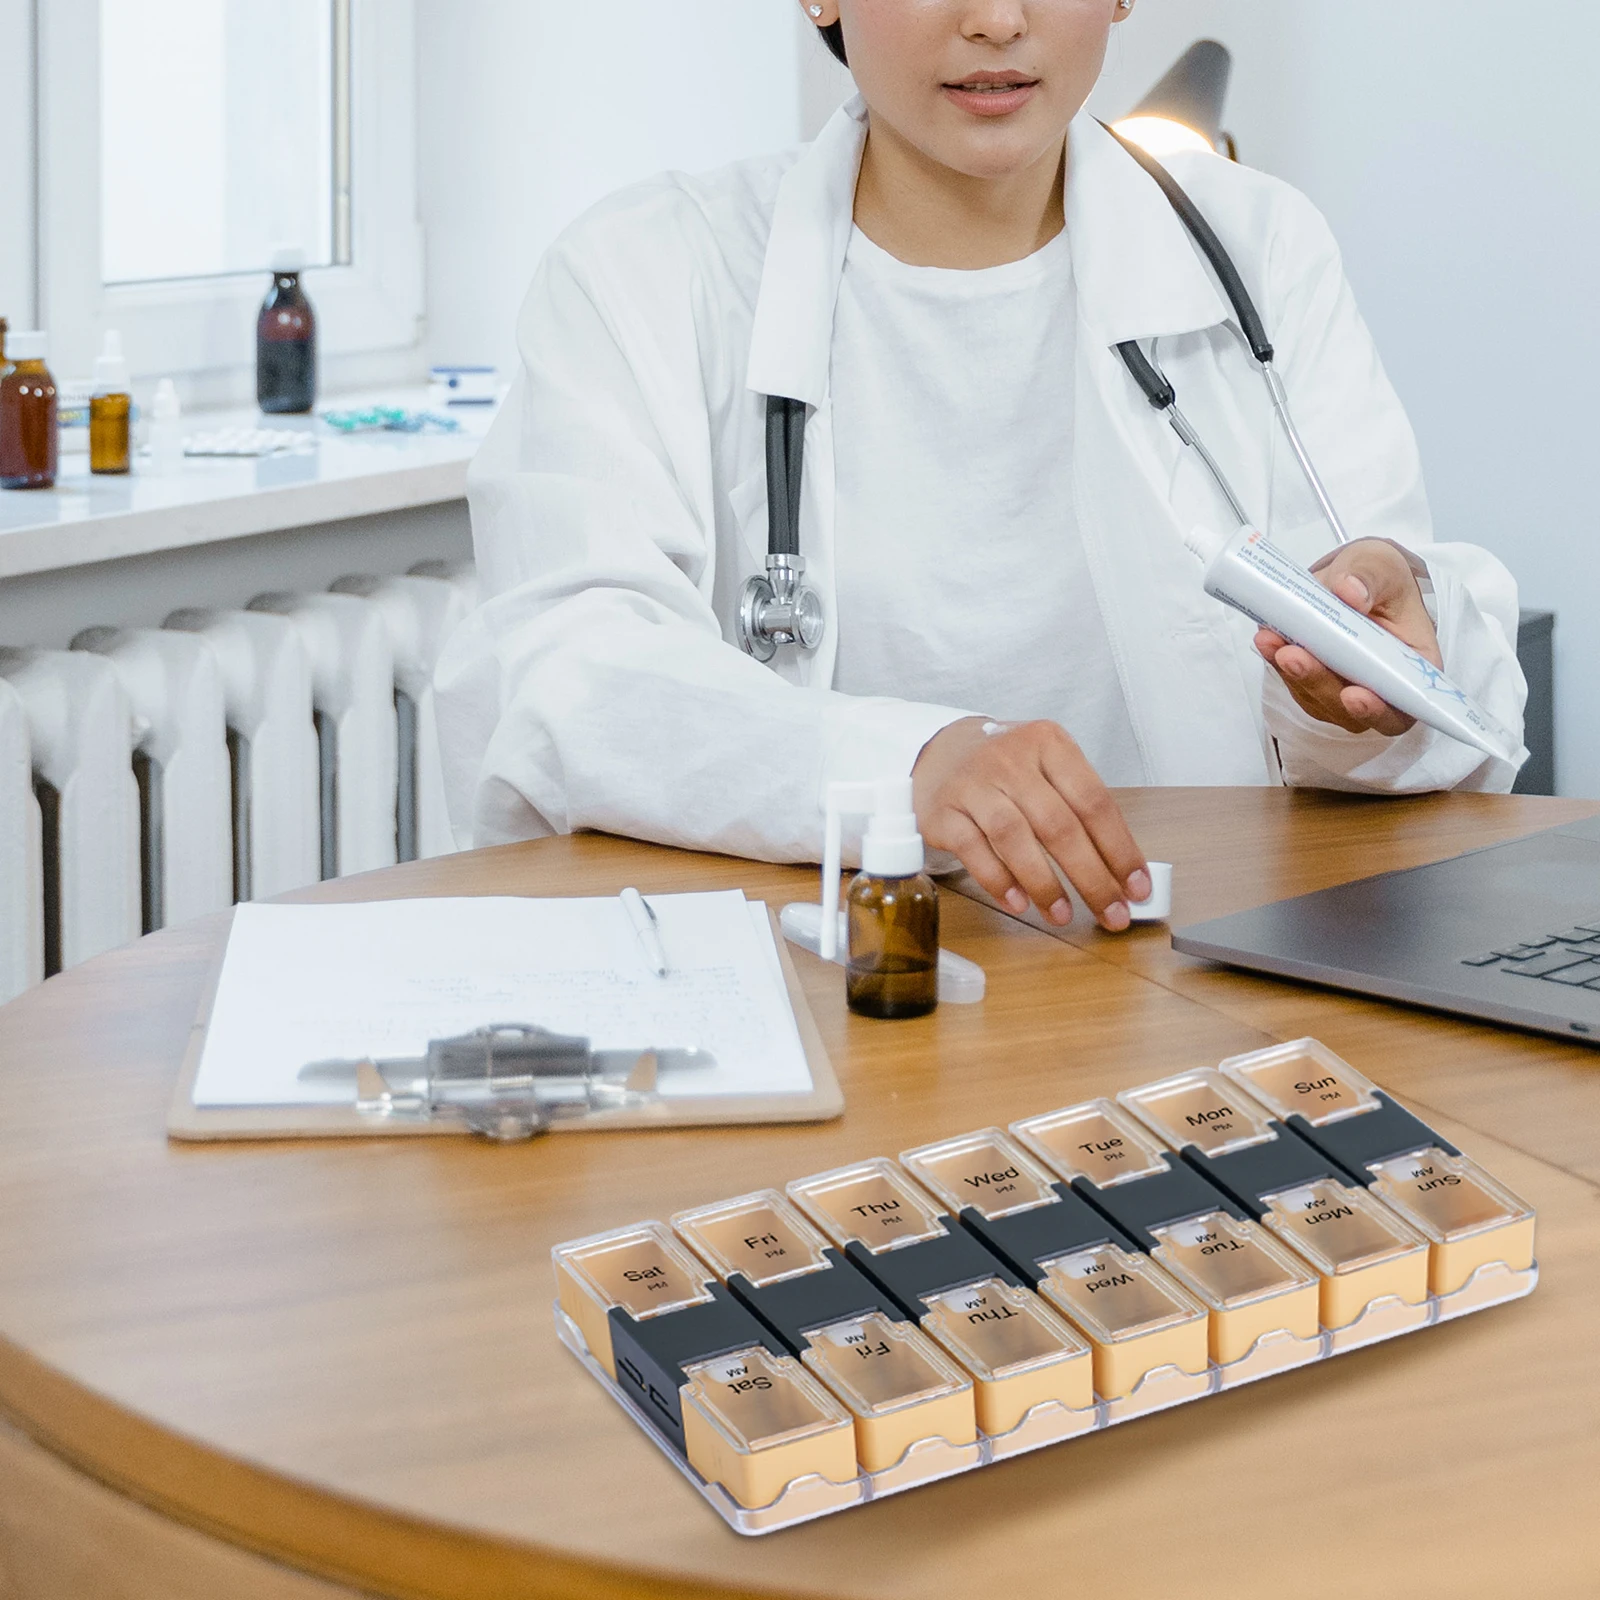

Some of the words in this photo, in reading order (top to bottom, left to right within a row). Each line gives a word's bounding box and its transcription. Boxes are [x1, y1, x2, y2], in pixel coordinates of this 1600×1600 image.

[1294, 1076, 1338, 1096] Sun
[1319, 1091, 1342, 1102] PM
[1185, 1106, 1234, 1127] Mon
[1211, 1122, 1234, 1133] PM
[1078, 1137, 1124, 1156] Tue
[1103, 1151, 1126, 1163] PM
[963, 1166, 1020, 1188] Wed
[1411, 1166, 1435, 1179] AM
[994, 1184, 1017, 1195] PM
[1417, 1174, 1462, 1192] Sun
[850, 1199, 901, 1219] Thu
[1304, 1198, 1327, 1211] AM
[881, 1215, 903, 1227] PM
[1305, 1205, 1354, 1226] Mon
[743, 1232, 779, 1250] Fri
[1195, 1232, 1218, 1244] AM
[765, 1248, 787, 1259] PM
[1200, 1238, 1246, 1256] Tue
[623, 1265, 666, 1283] Sat
[1083, 1263, 1107, 1275] AM
[647, 1280, 669, 1292] PM
[1086, 1272, 1135, 1294] Wed
[964, 1297, 988, 1310] AM
[968, 1304, 1020, 1325] Thu
[844, 1333, 868, 1345] AM
[855, 1341, 892, 1359] Fri
[726, 1365, 750, 1378] AM
[727, 1376, 773, 1396] Sat
